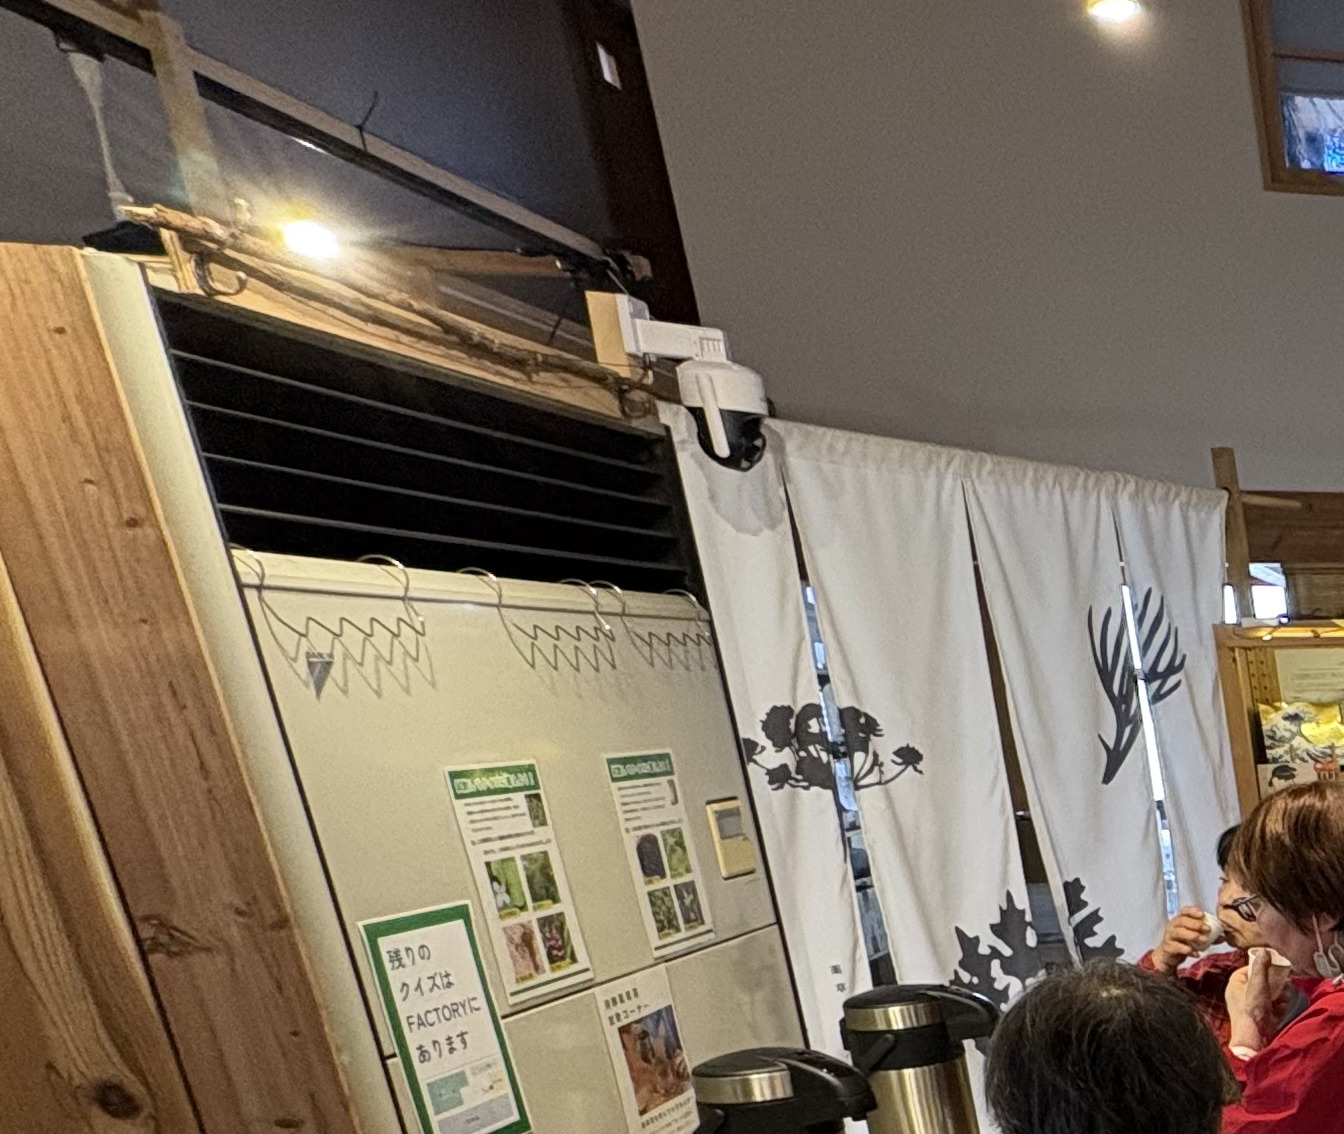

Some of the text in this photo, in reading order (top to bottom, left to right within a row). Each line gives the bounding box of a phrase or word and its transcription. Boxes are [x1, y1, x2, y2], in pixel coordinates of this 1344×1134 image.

[385, 944, 432, 972] 残りの
[399, 971, 455, 1002] クイズは
[406, 996, 482, 1033] FACTORYに
[415, 1030, 470, 1064] あります
